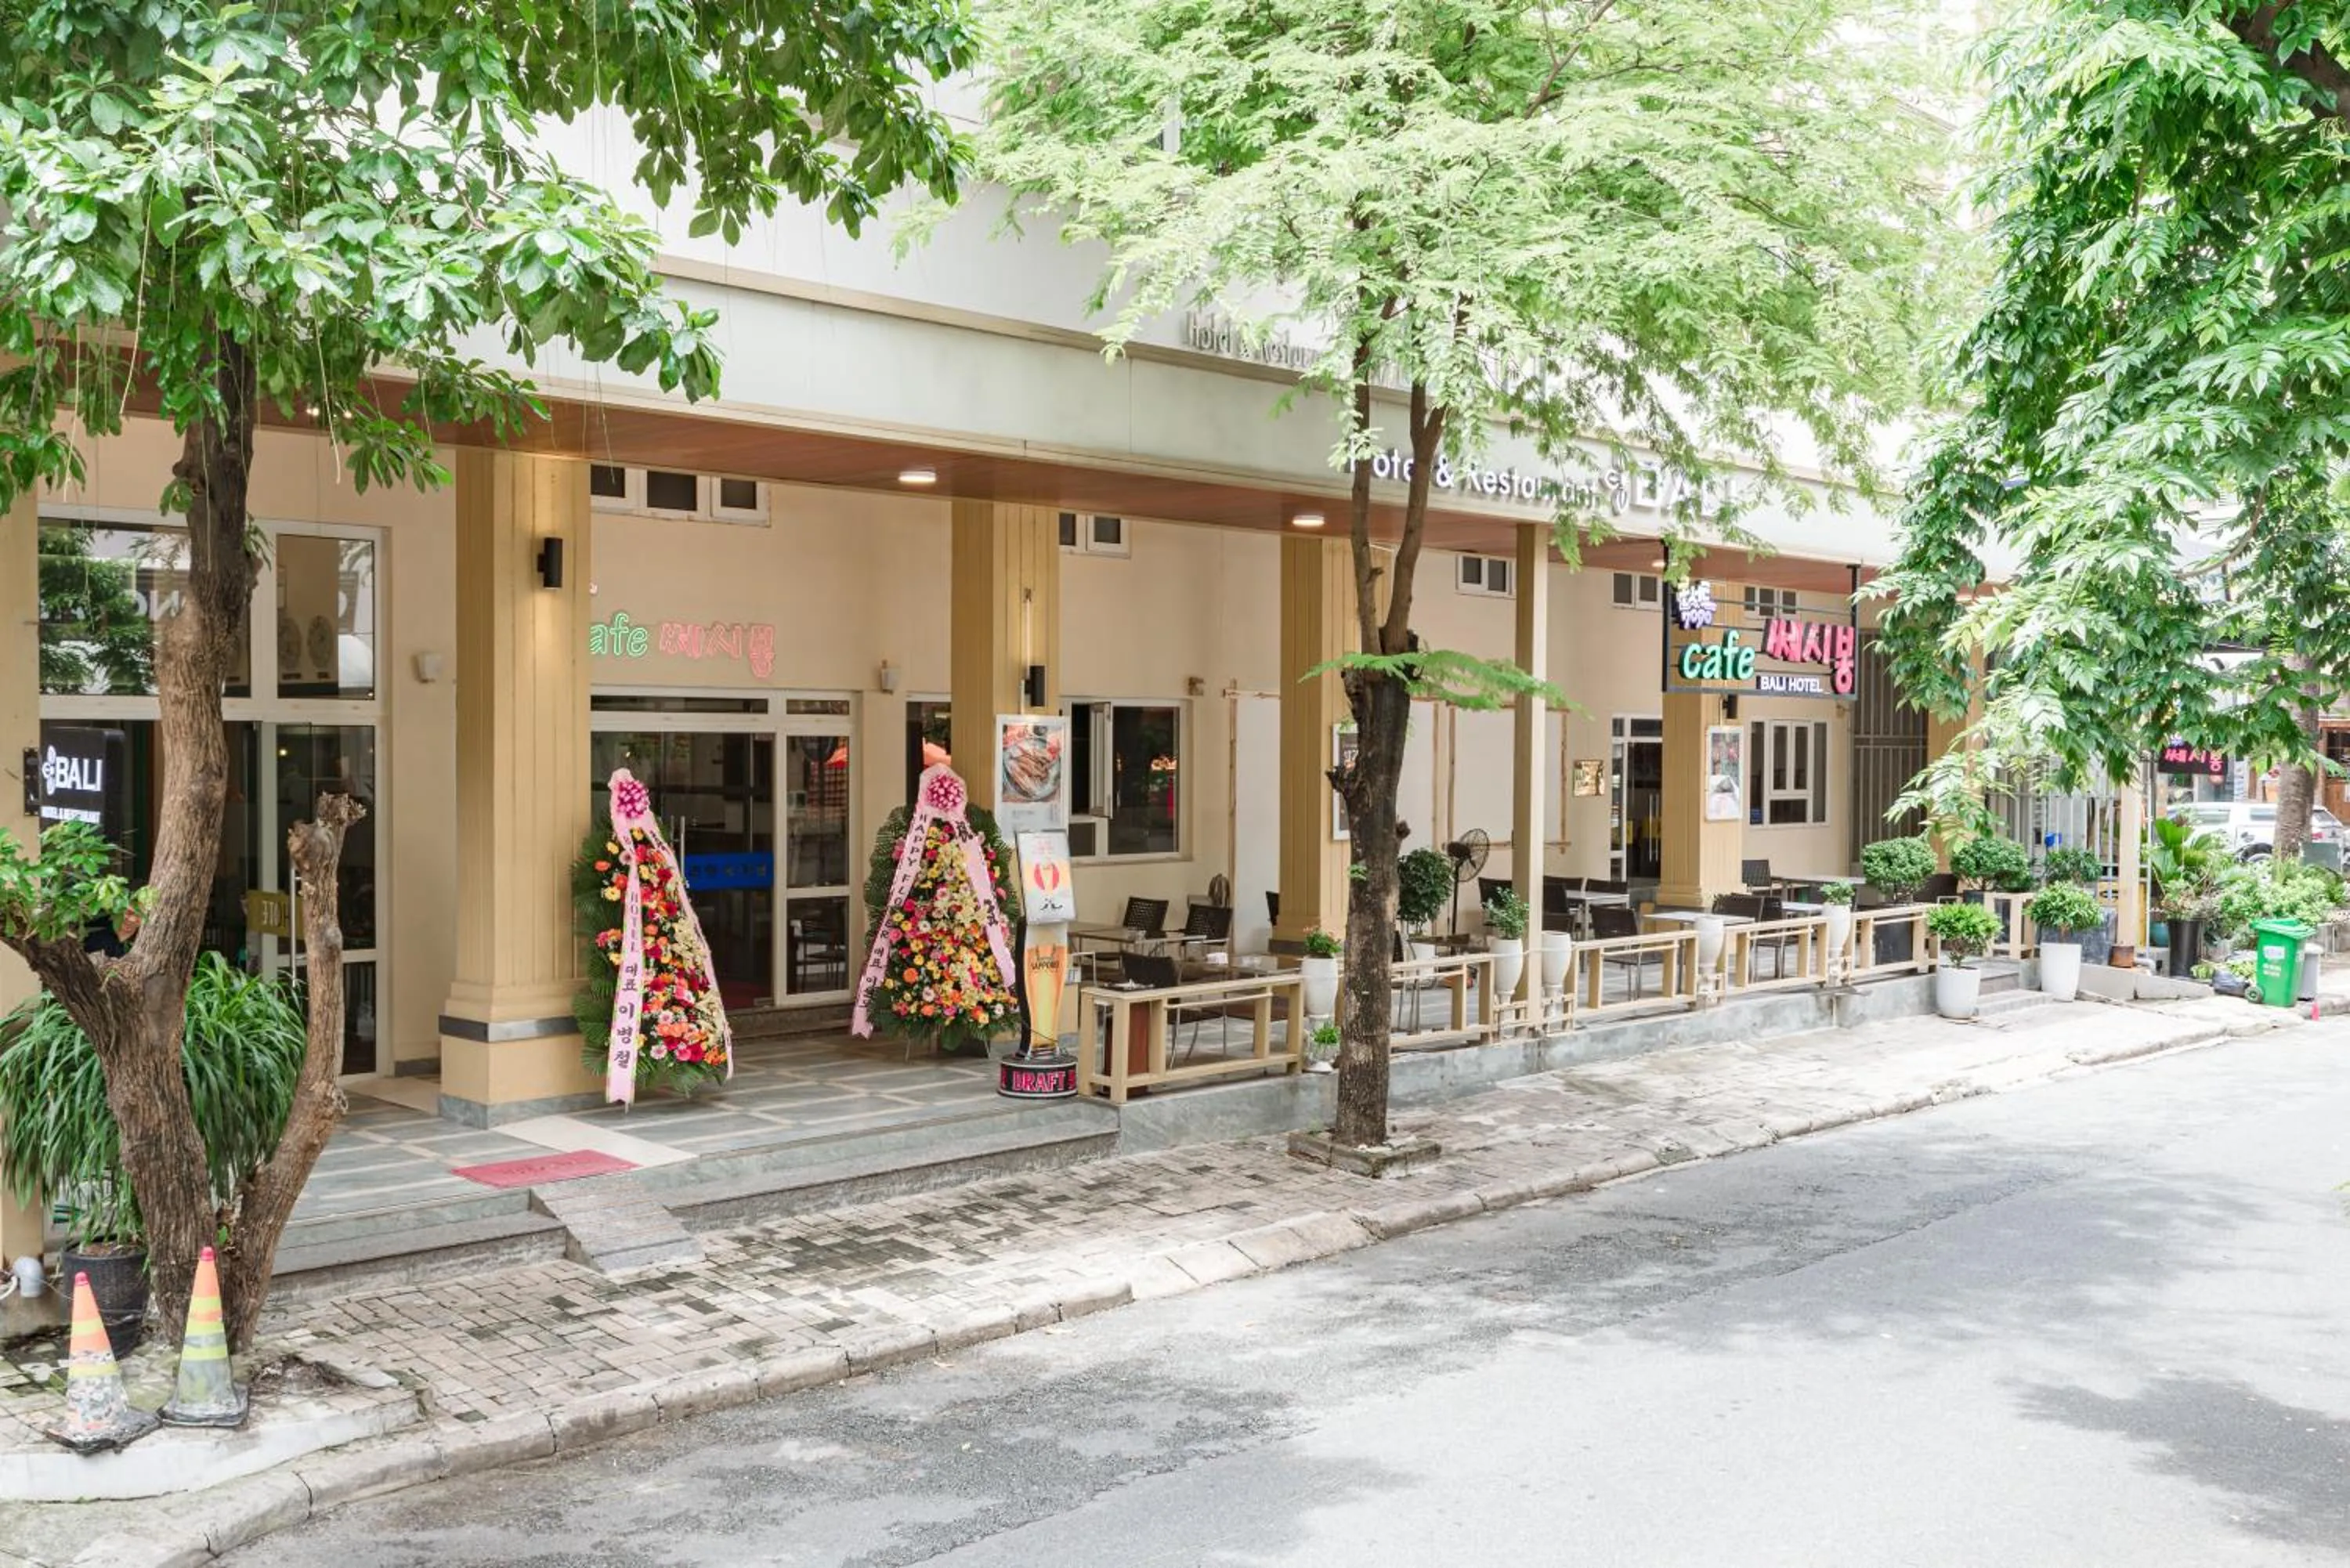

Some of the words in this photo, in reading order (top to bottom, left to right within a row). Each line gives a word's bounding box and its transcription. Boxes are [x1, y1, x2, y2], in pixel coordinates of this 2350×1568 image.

[1435, 454, 1455, 488] &
[589, 612, 649, 657] afe
[1682, 629, 1755, 679] cafe
[1760, 676, 1786, 691] BALI
[1788, 677, 1824, 692] HOTEL
[56, 757, 103, 791] BALI
[907, 814, 927, 866] HAPPY
[880, 873, 912, 939] FLOER
[1012, 1071, 1066, 1092] DRAFT
